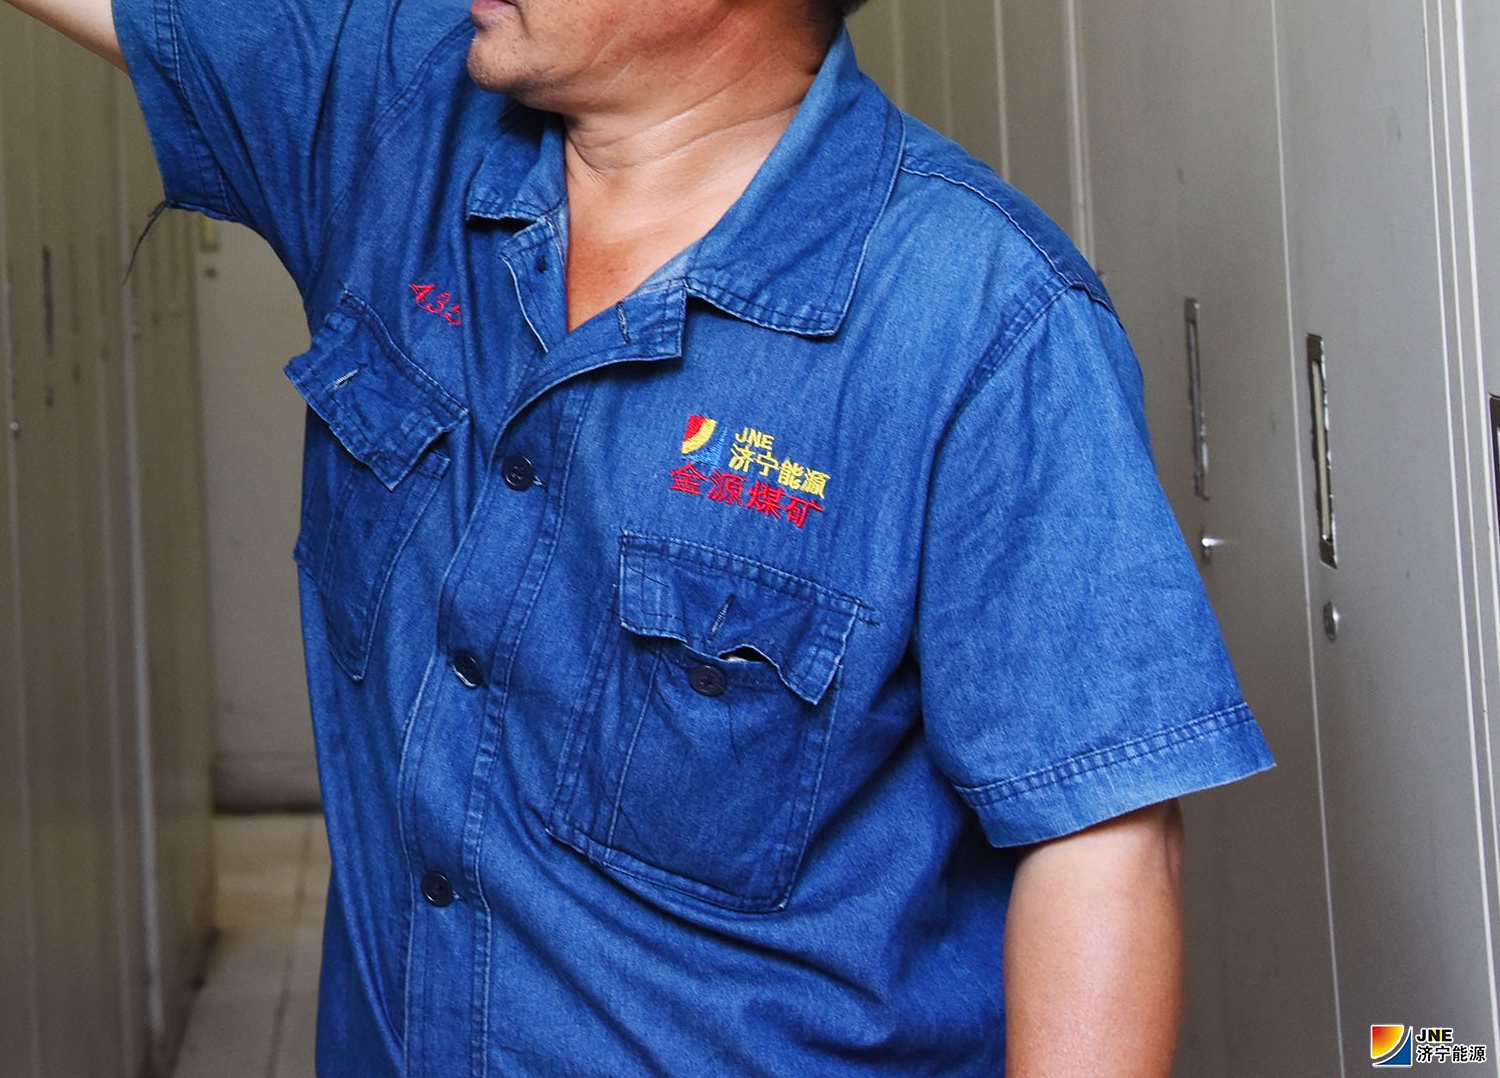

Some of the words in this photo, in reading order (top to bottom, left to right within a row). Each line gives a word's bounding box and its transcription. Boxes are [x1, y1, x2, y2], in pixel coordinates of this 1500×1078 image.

[735, 427, 775, 451] JNE
[670, 462, 824, 529] 金源煤矿
[728, 443, 831, 499] 济宁能源
